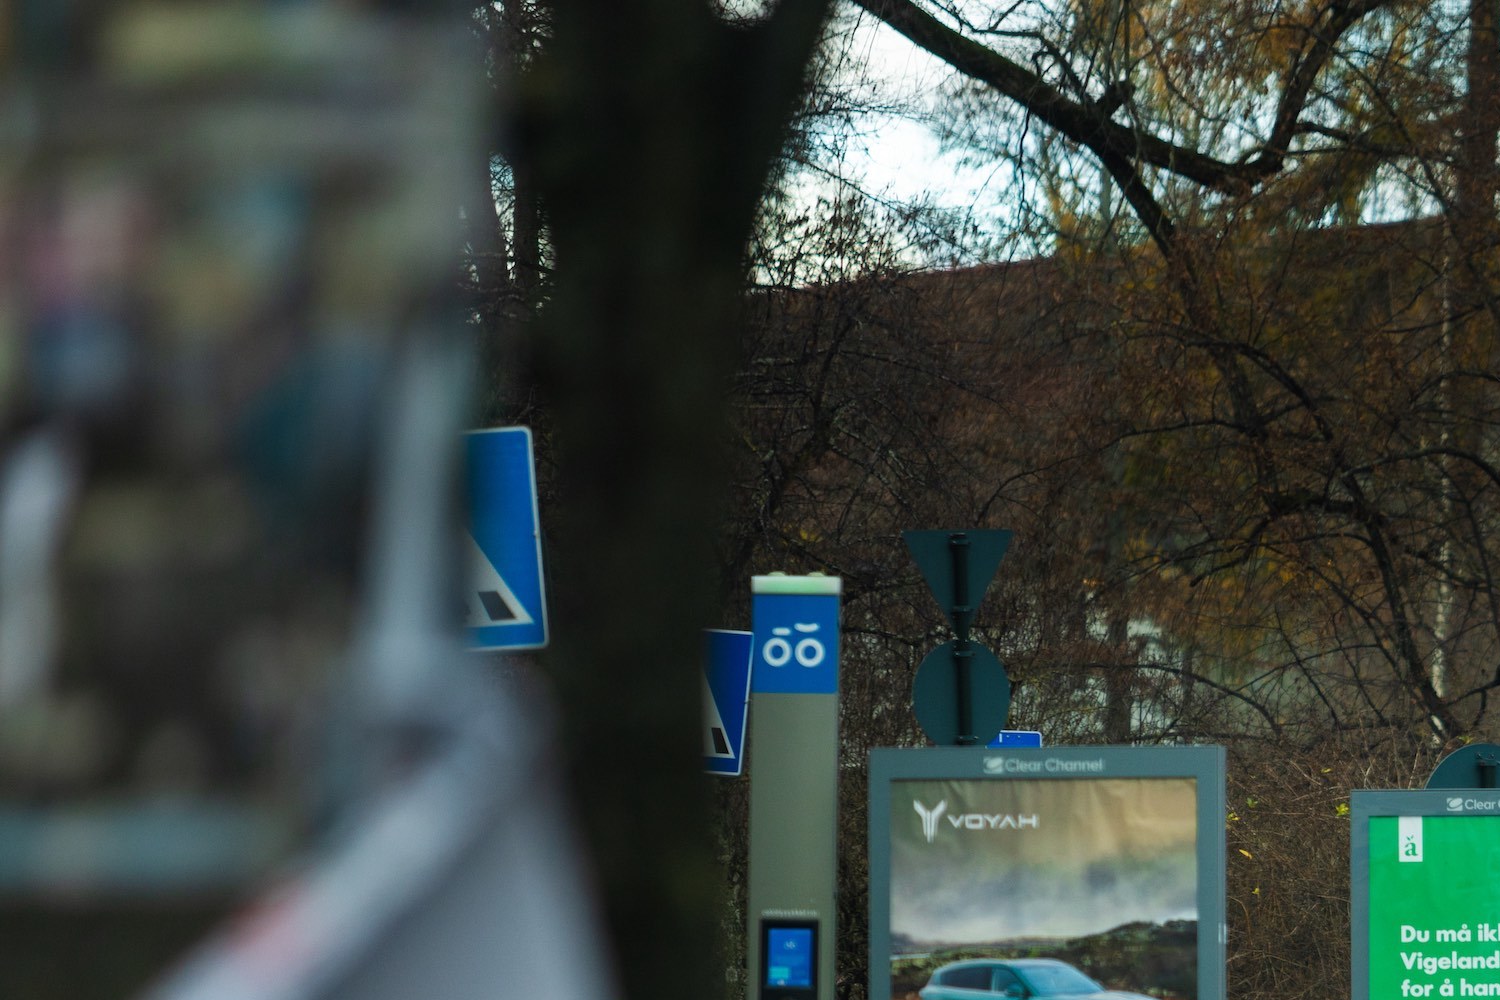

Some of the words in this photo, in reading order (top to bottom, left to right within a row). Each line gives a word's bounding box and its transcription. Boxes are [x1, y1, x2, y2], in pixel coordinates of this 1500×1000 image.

[1005, 758, 1041, 772] Clear
[1045, 758, 1105, 772] Channel
[1465, 799, 1496, 810] Clear
[947, 813, 1038, 829] VOYAH
[1401, 925, 1429, 942] Du
[1436, 924, 1471, 942] må
[1401, 979, 1433, 997] for
[1440, 978, 1454, 996] å
